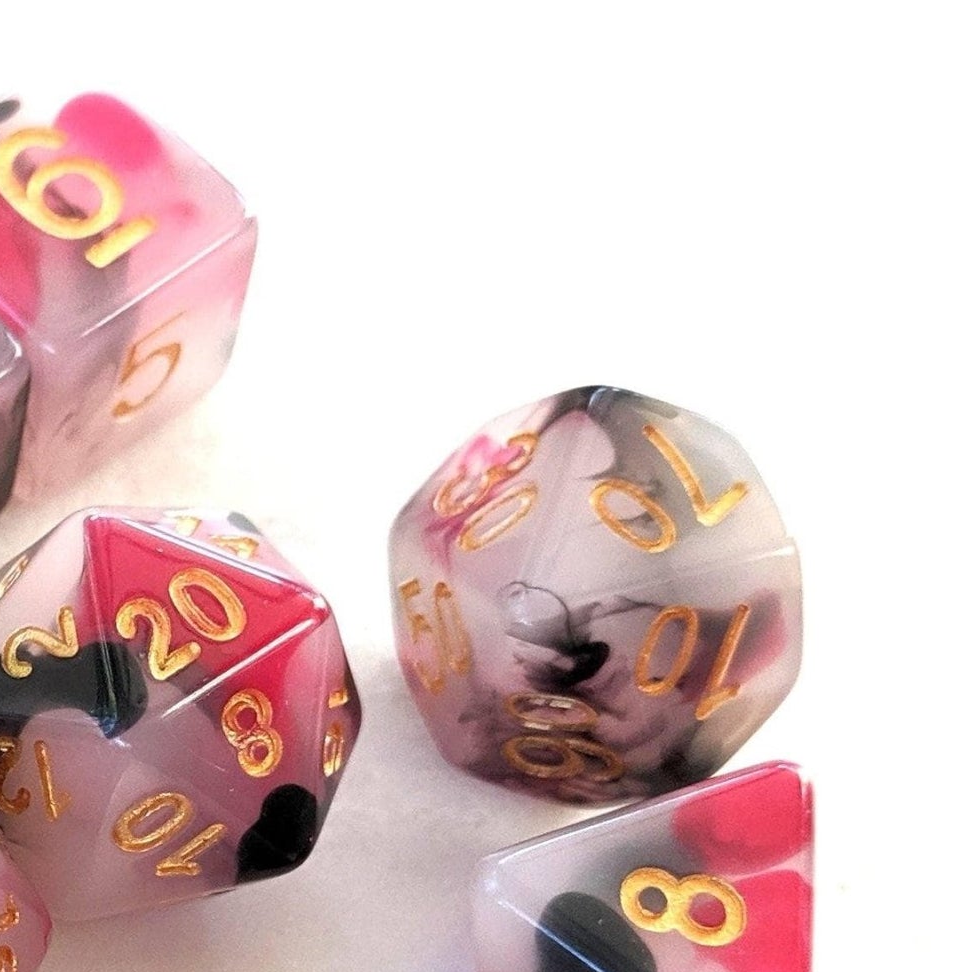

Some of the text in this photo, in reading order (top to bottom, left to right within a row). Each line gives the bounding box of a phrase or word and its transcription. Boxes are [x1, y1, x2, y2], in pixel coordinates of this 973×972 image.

[112, 311, 187, 423] 5
[588, 425, 748, 553] 70
[1, 606, 78, 678] 2
[116, 567, 247, 681] 20
[634, 605, 750, 721] 10
[221, 689, 283, 778] 8
[112, 792, 226, 877] 10
[619, 866, 747, 947] 8
